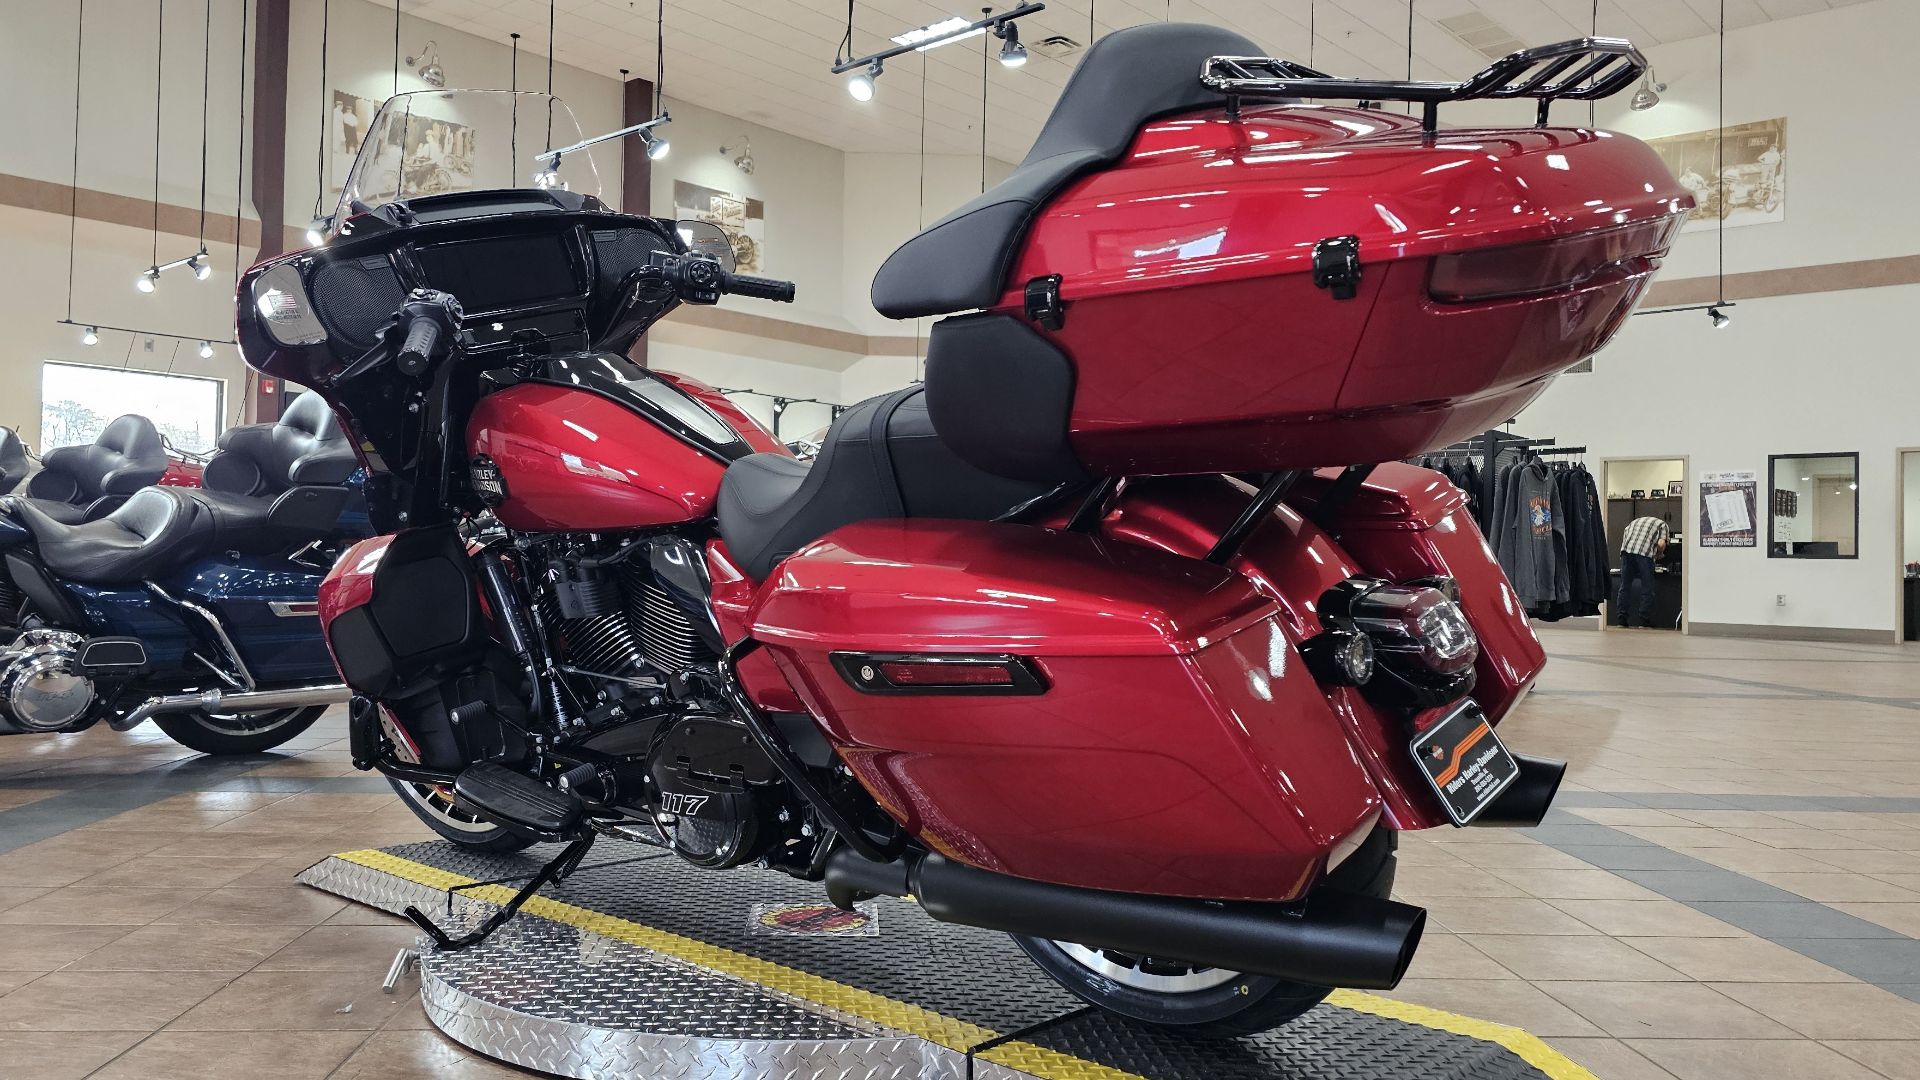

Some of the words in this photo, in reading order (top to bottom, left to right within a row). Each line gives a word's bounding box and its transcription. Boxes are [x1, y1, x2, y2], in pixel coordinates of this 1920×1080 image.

[1446, 776, 1466, 794] Riders
[1462, 745, 1499, 780] Harley-Davidson
[662, 791, 709, 815] 117
